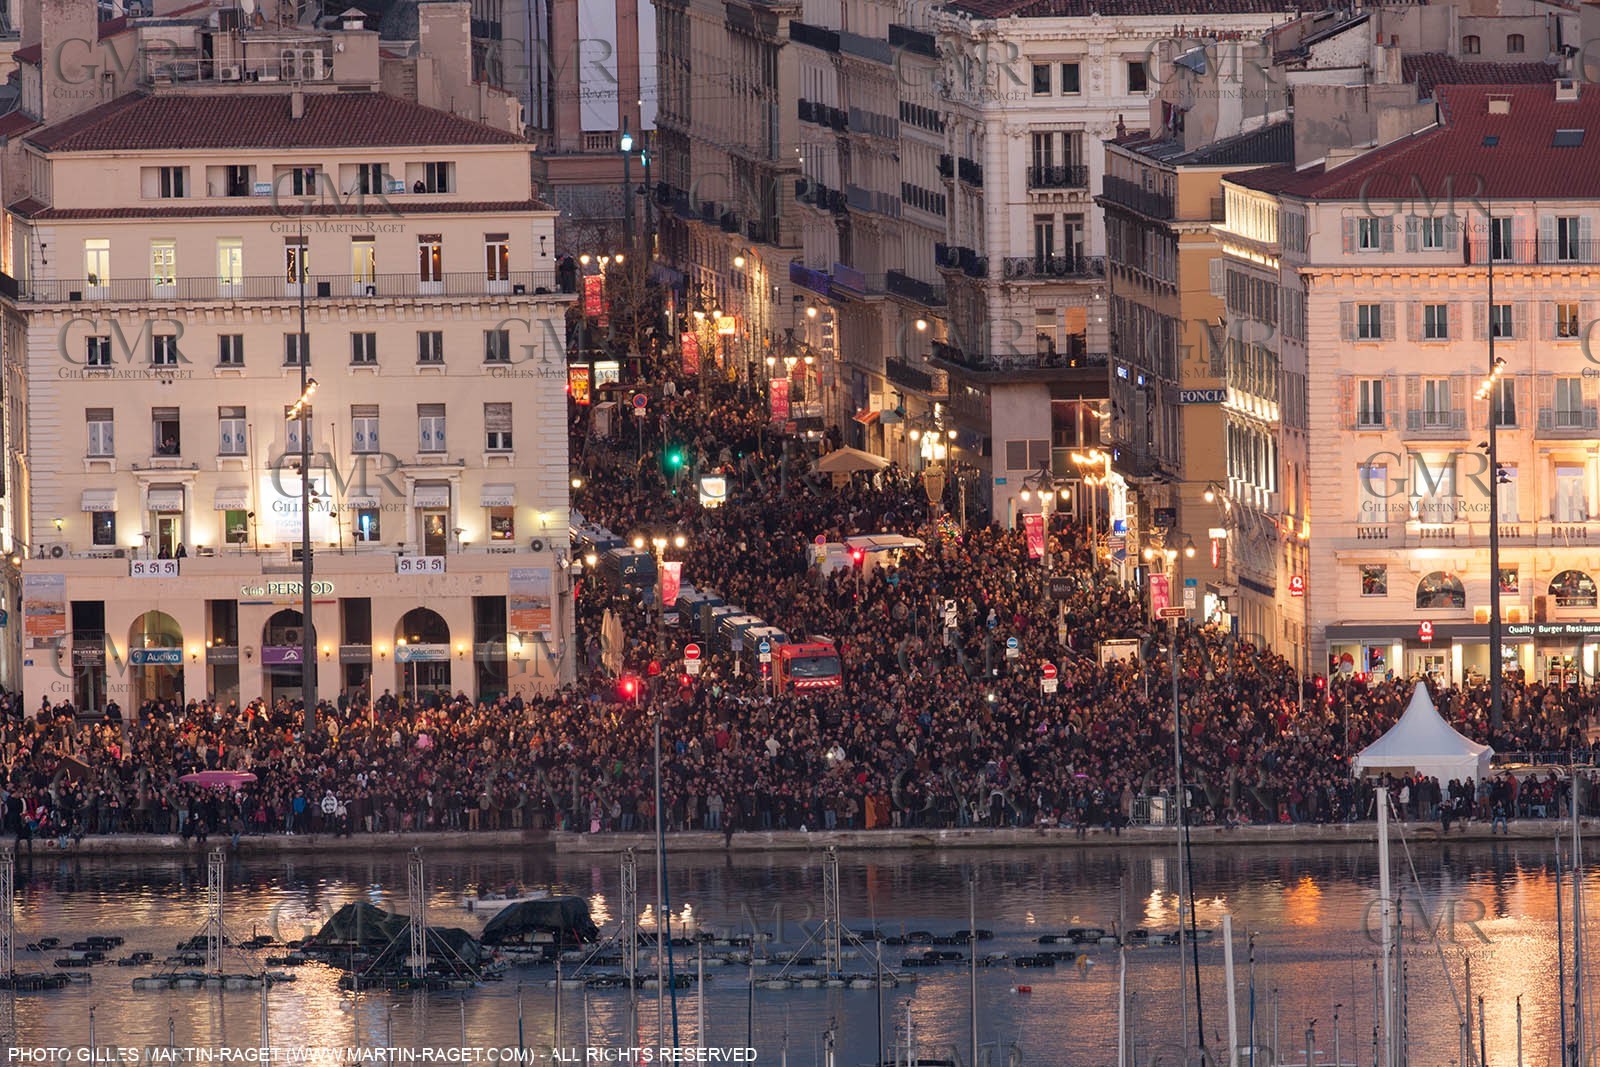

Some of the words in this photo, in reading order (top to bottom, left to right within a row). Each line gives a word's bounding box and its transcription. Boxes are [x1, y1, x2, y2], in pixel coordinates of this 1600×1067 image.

[1180, 390, 1226, 402] FONCIA
[134, 562, 144, 573] 51
[149, 562, 159, 573] 51
[165, 562, 175, 573] 51
[401, 559, 411, 570] 51
[416, 559, 426, 570] 51
[431, 559, 441, 570] 51
[1508, 626, 1535, 634] Quality
[1538, 625, 1563, 634] Burger
[1566, 625, 1600, 633] Restaura
[147, 653, 178, 661] Audika
